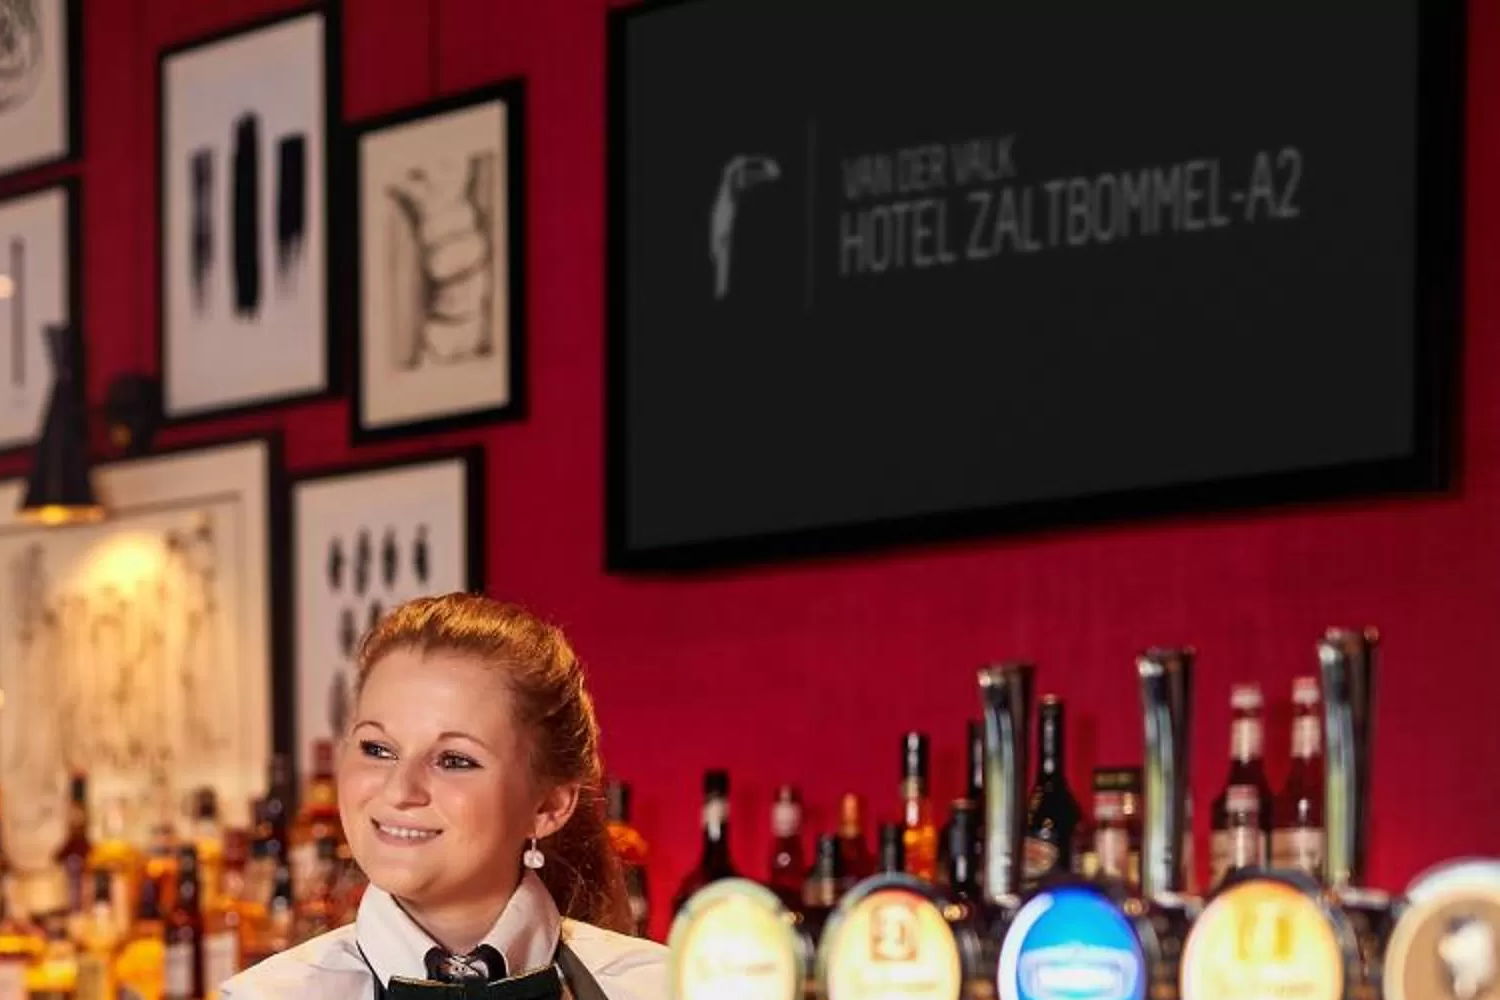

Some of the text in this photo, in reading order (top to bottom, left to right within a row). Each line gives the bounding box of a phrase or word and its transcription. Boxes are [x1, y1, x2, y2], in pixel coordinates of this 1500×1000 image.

[840, 146, 1303, 276] HOTEL ZALTBOMMEL-A2
[842, 134, 1016, 201] VAN DER VALK
